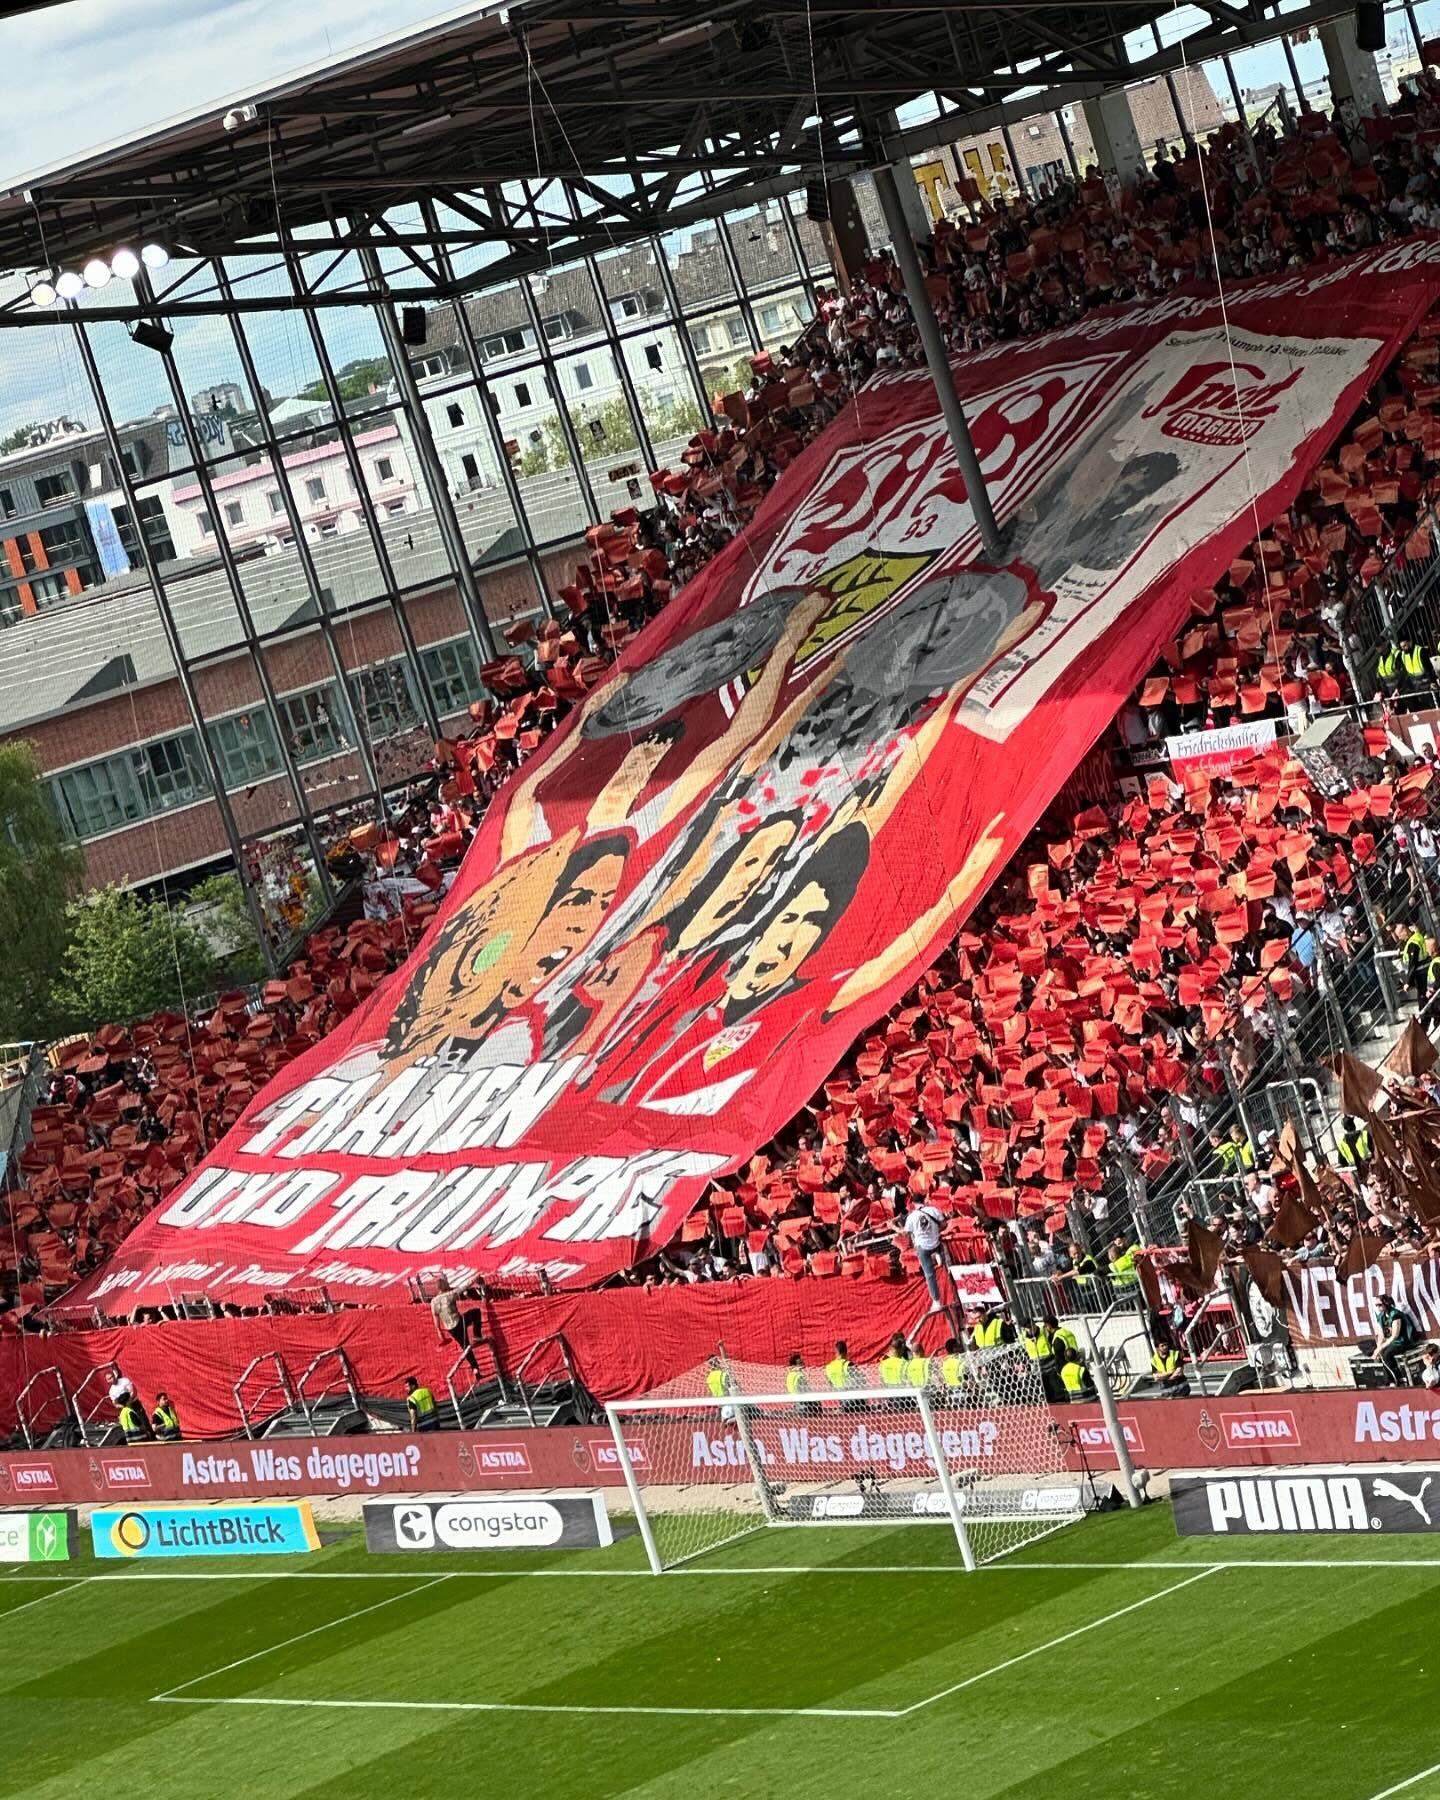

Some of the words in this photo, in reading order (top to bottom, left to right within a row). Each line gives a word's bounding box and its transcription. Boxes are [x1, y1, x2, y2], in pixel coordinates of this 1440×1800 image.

[1360, 240, 1440, 276] 189
[794, 557, 829, 582] 18
[898, 513, 939, 543] 93
[237, 1053, 588, 1159] TRÄNEN
[156, 1167, 341, 1229] UND
[780, 1427, 844, 1463] Was
[1079, 1425, 1137, 1445] ASTA
[1230, 1419, 1292, 1440] ASTRA
[182, 1452, 248, 1485] Astra.
[250, 1448, 302, 1481] Was
[307, 1445, 421, 1488] dagegen?
[481, 1450, 526, 1468] ASTRA
[597, 1447, 645, 1463] ASRA
[17, 1469, 53, 1484] ASTRA
[108, 1466, 146, 1482] ASTRA
[1206, 1477, 1370, 1532] PUMA
[156, 1513, 286, 1547] LichtBlick
[448, 1511, 549, 1538] congstar
